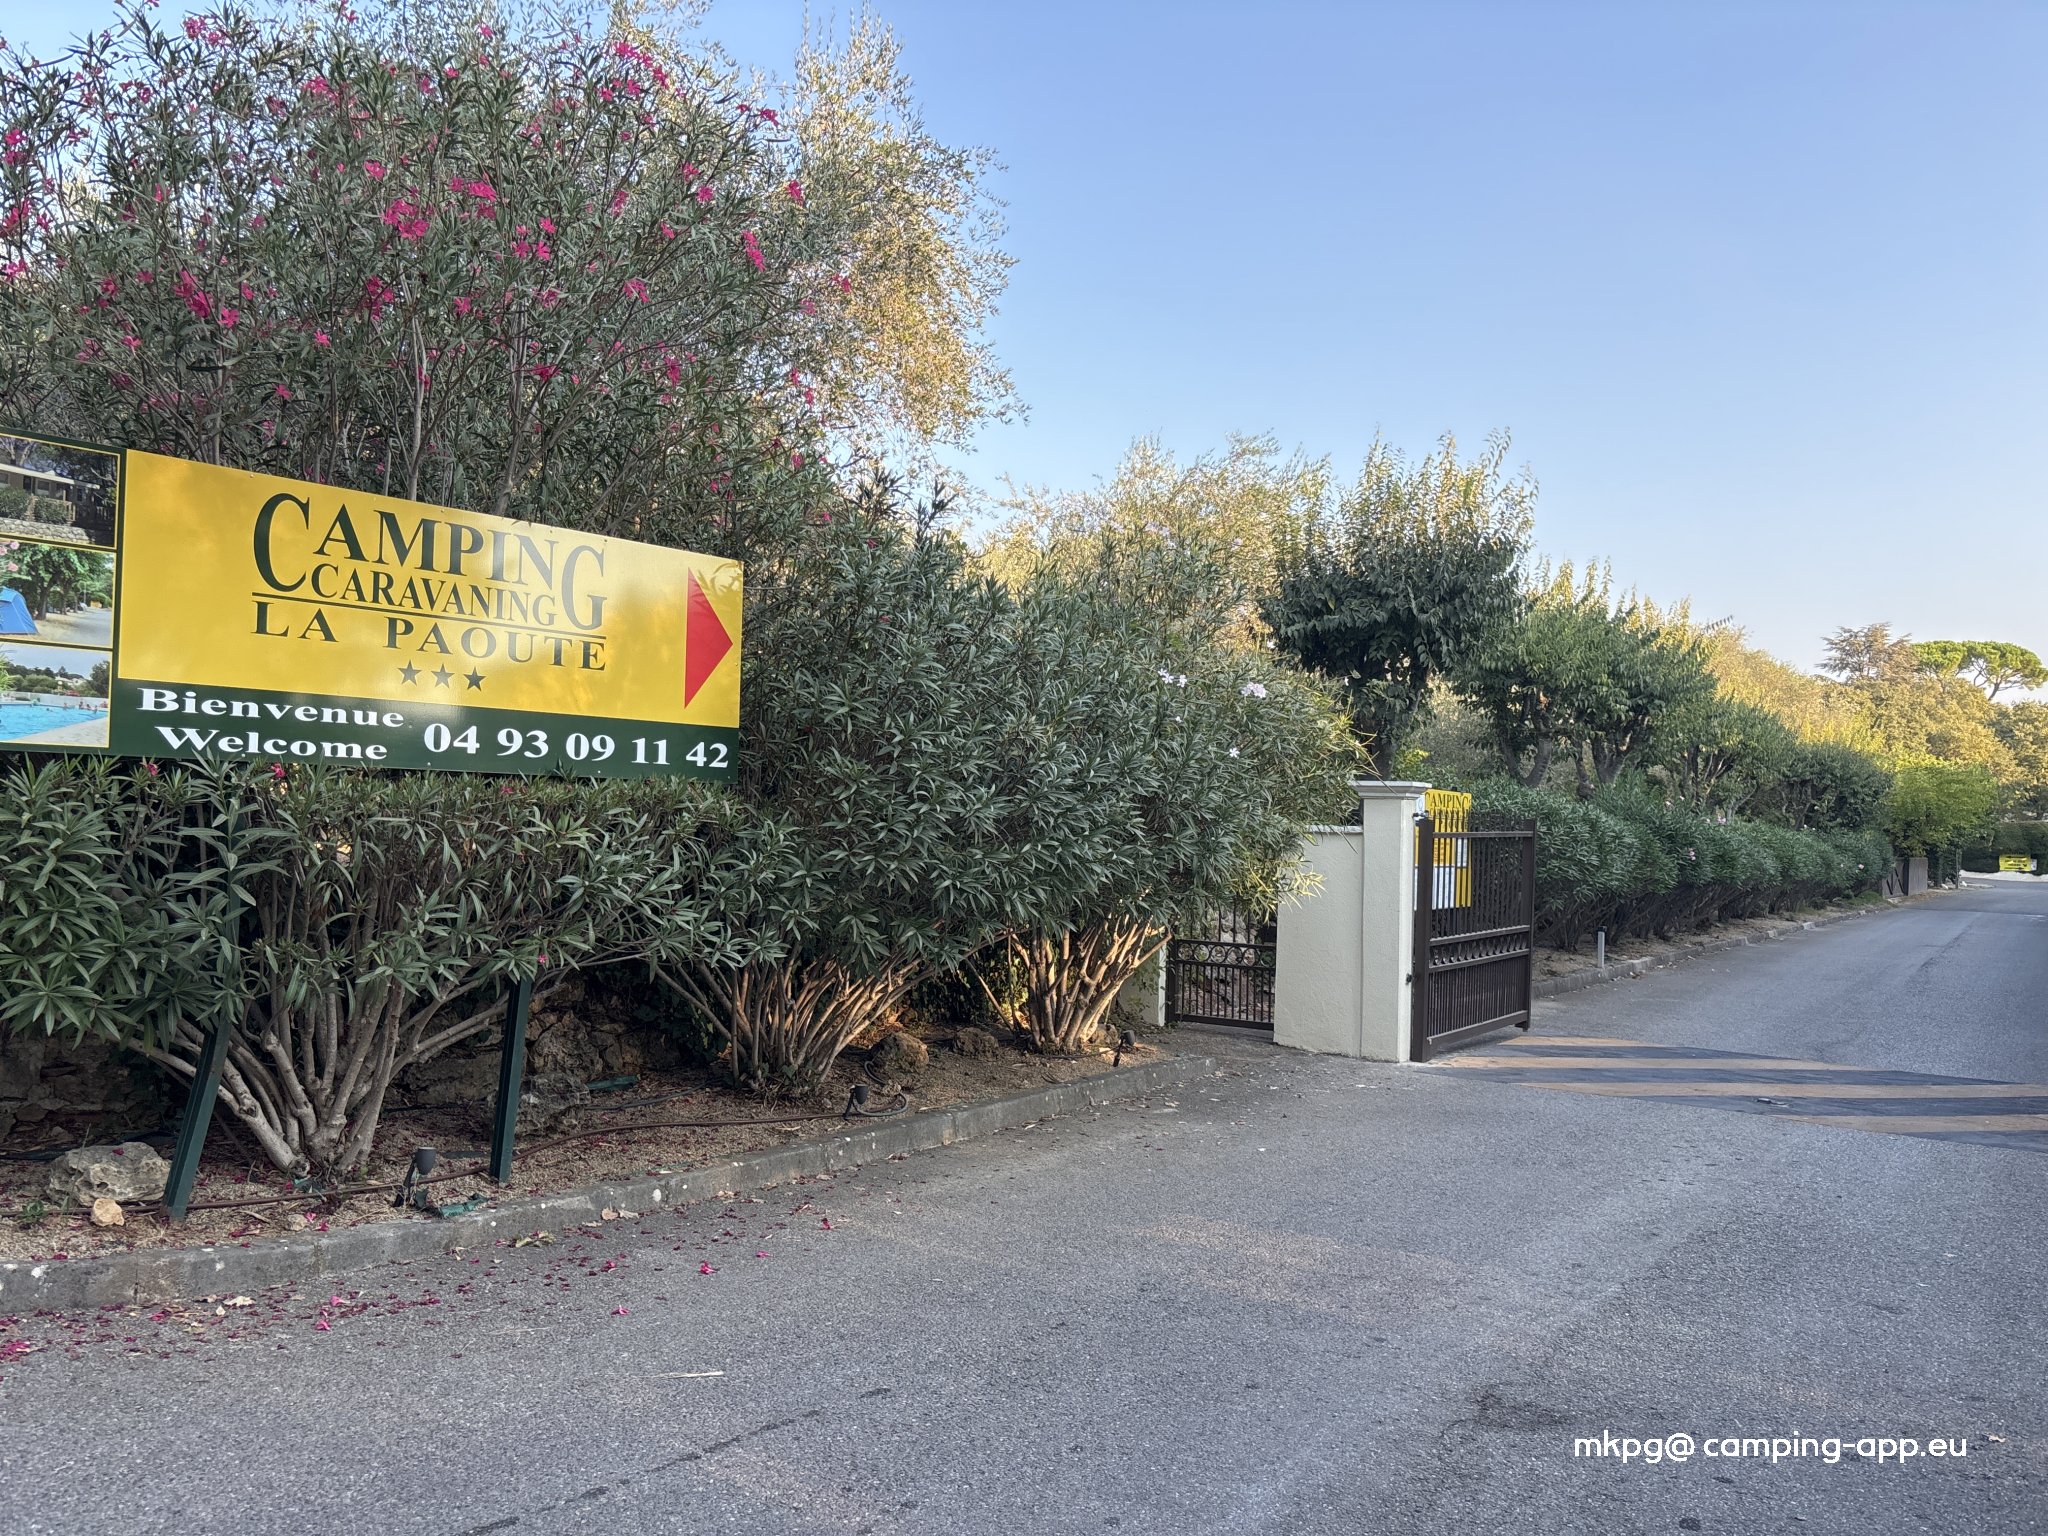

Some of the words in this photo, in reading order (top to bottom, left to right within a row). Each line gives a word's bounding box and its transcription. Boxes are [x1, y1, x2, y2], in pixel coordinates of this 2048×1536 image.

[254, 493, 607, 630] CAMPING
[311, 563, 557, 626] CARAVANING
[251, 600, 339, 642] LA
[383, 616, 606, 671] PAOUTE
[136, 688, 404, 728] Bienvenue
[154, 726, 388, 760] Welcome
[424, 723, 480, 754] 04
[497, 728, 549, 758] 93
[566, 733, 615, 761] 09
[631, 737, 670, 765] 11
[685, 741, 728, 768] 42
